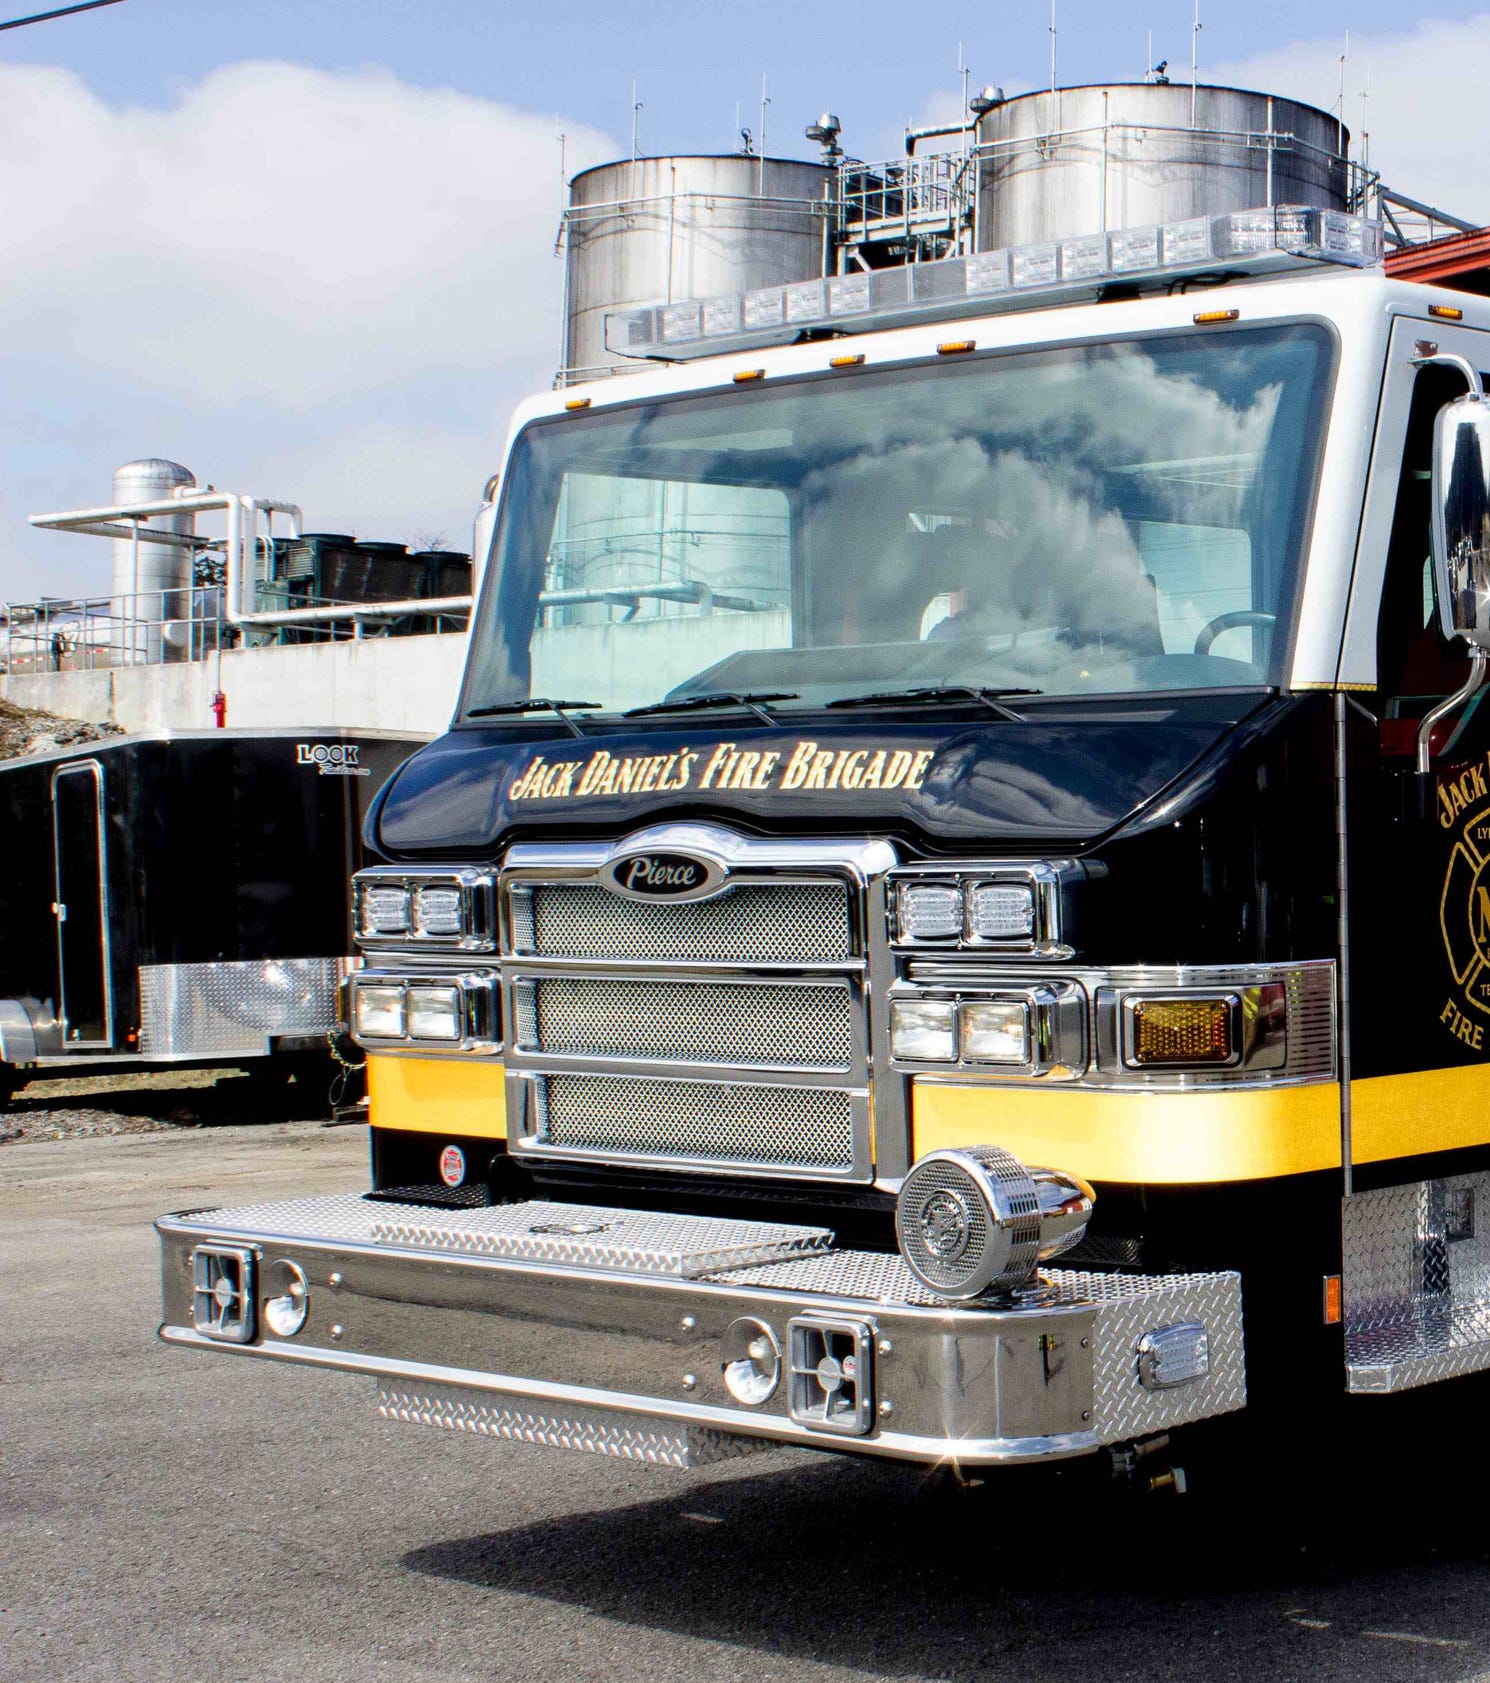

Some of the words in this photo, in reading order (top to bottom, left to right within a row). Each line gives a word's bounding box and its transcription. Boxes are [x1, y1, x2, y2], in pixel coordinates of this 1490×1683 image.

[296, 744, 359, 764] LOOK
[509, 756, 583, 800] JACK
[575, 747, 698, 796] DANIEL'S
[699, 742, 781, 791] FIRE
[779, 742, 935, 791] BRIGADE
[1437, 762, 1489, 829] JACK
[625, 856, 697, 890] Pierce
[1439, 997, 1484, 1051] FIRE
